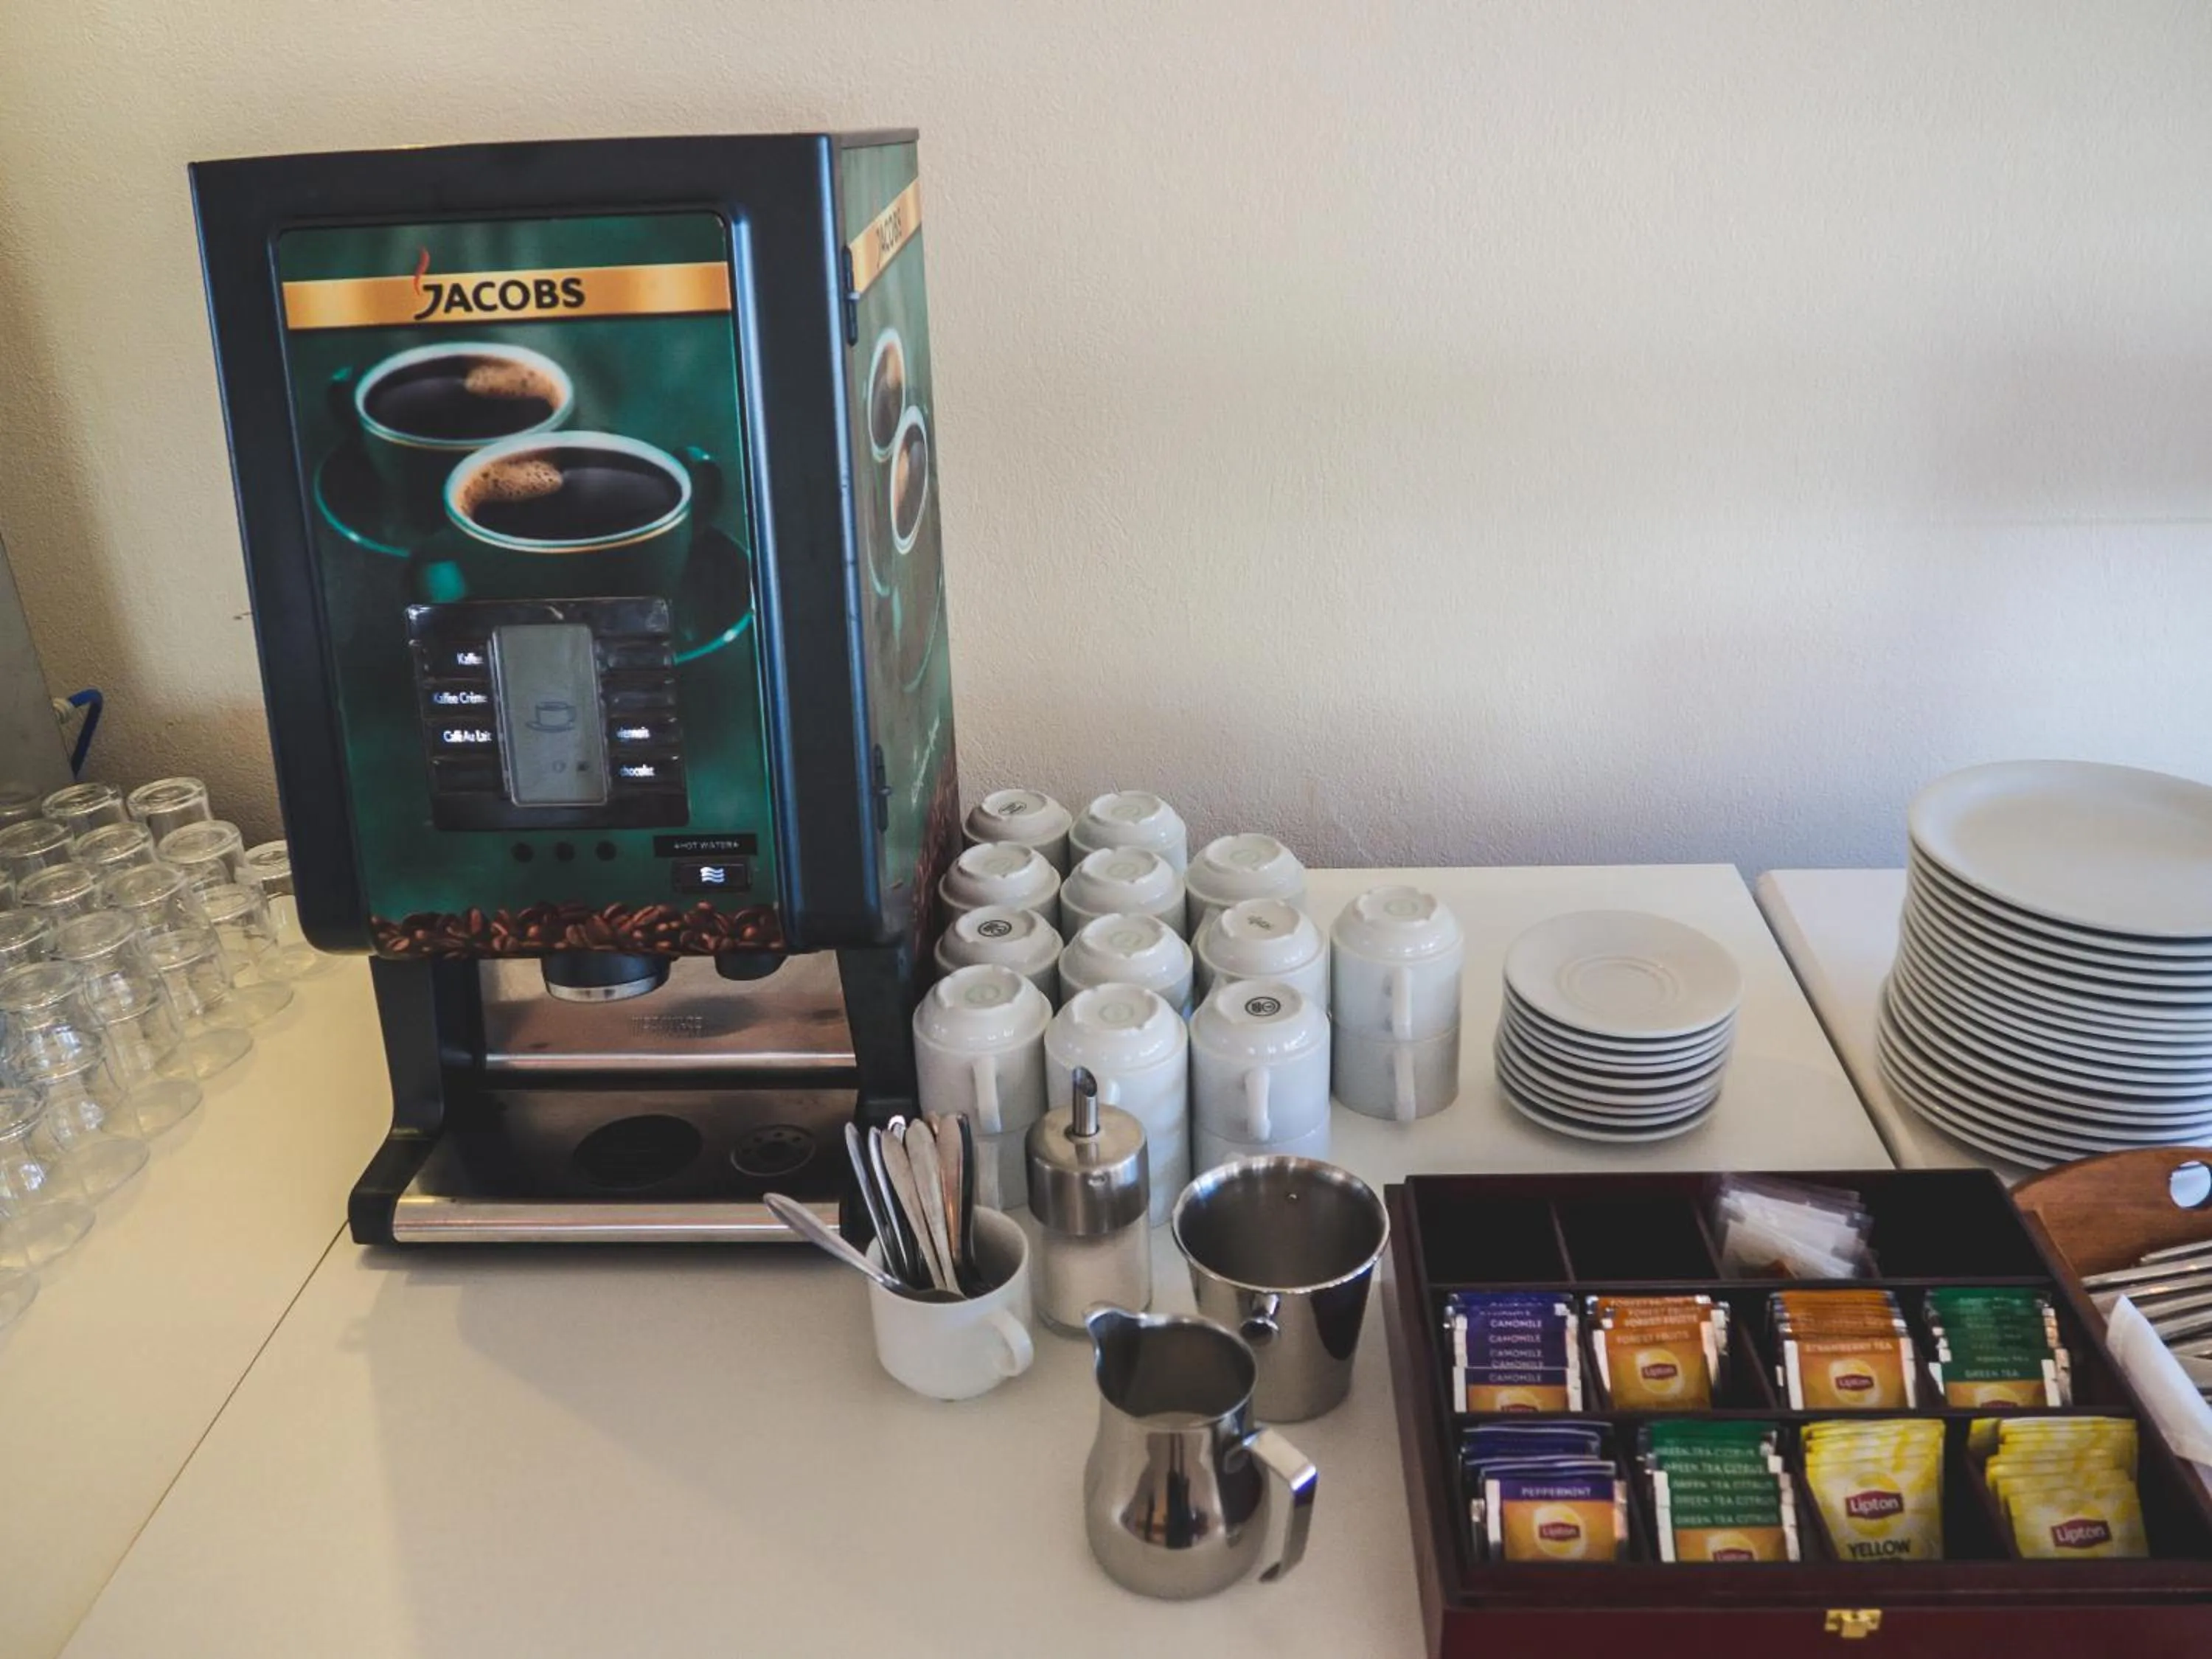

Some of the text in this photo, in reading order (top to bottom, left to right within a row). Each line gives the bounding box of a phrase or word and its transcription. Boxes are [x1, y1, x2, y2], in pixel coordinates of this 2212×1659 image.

[414, 277, 585, 320] JACOBS
[1489, 1319, 1543, 1328] CAMOMILE
[1489, 1335, 1541, 1343] CAMOMILE
[1489, 1349, 1543, 1357] CAMOMILE
[1489, 1373, 1541, 1382] CAMOMILE
[1522, 1486, 1590, 1497] PEPPERMINT
[1850, 1498, 1899, 1515] Lipton
[2056, 1526, 2106, 1544] Lipton
[1846, 1538, 1911, 1559] YELLOW
